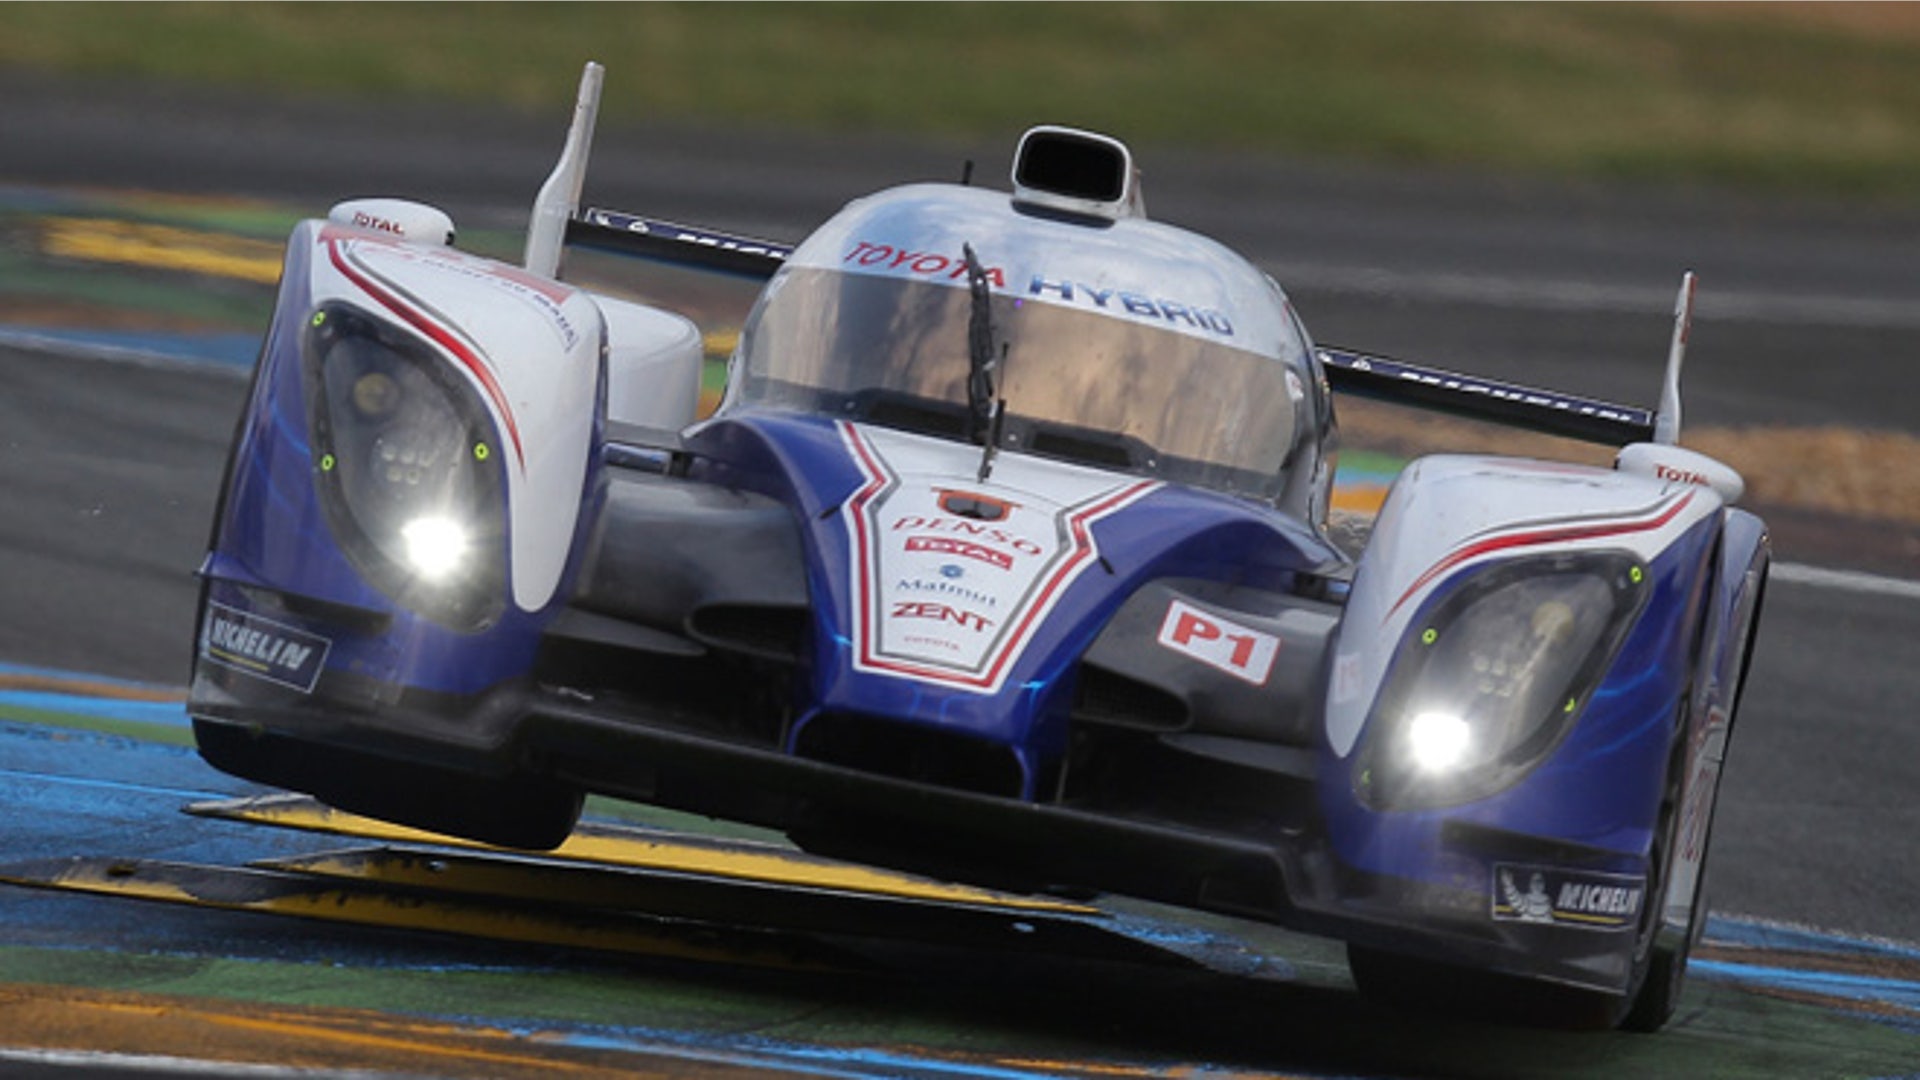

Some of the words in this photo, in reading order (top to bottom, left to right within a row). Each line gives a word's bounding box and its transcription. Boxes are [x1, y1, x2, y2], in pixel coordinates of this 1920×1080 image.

[843, 242, 1006, 287] TOYOTA
[1028, 274, 1234, 336] HYBRID
[891, 517, 1043, 555] DENSO
[890, 601, 996, 632] ZENT
[1172, 610, 1259, 668] P1
